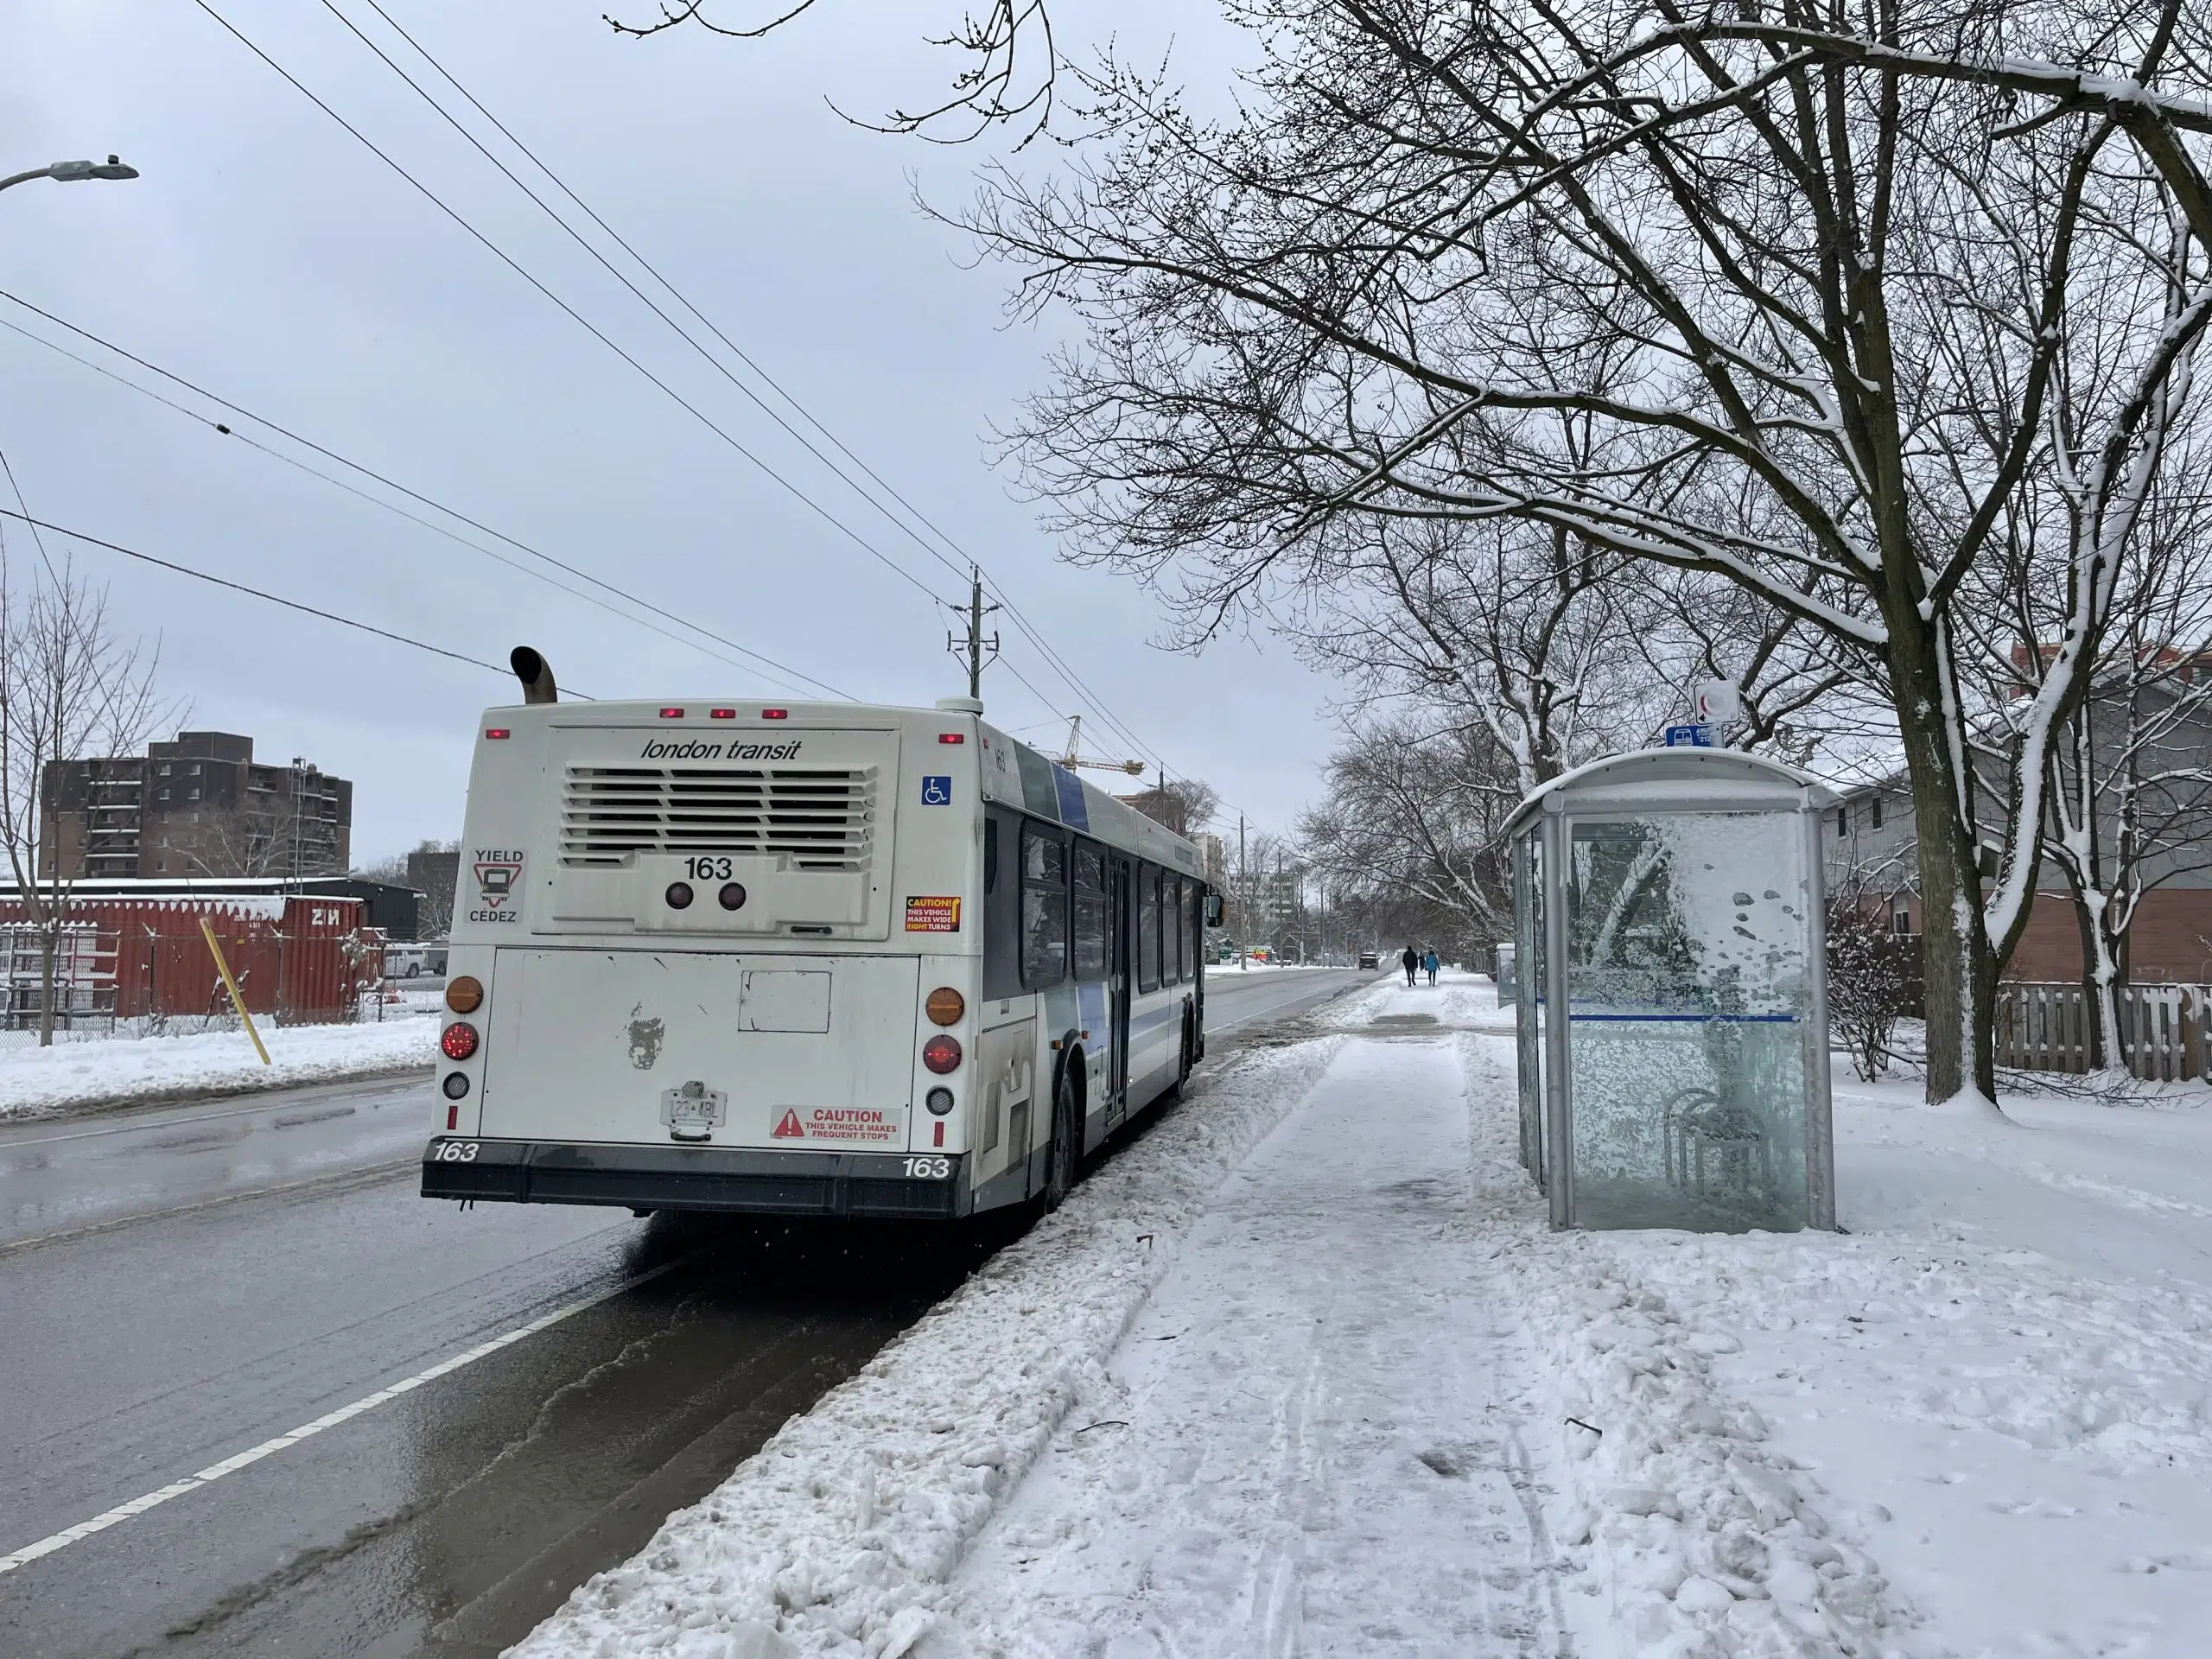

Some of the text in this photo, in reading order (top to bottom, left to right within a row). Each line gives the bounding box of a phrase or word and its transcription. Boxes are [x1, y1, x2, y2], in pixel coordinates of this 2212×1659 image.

[640, 739, 803, 760] london transit
[995, 748, 1006, 772] 163
[475, 849, 524, 862] YIELD
[684, 856, 733, 880] 163
[469, 907, 518, 923] CÉDEZ
[813, 1109, 883, 1123] CAUTION
[811, 1130, 889, 1141] FREQUENT STOPS
[828, 1122, 864, 1131] VEHICLE
[867, 1124, 897, 1133] MAKES
[435, 1141, 480, 1162] 163
[902, 1158, 950, 1179] 163
